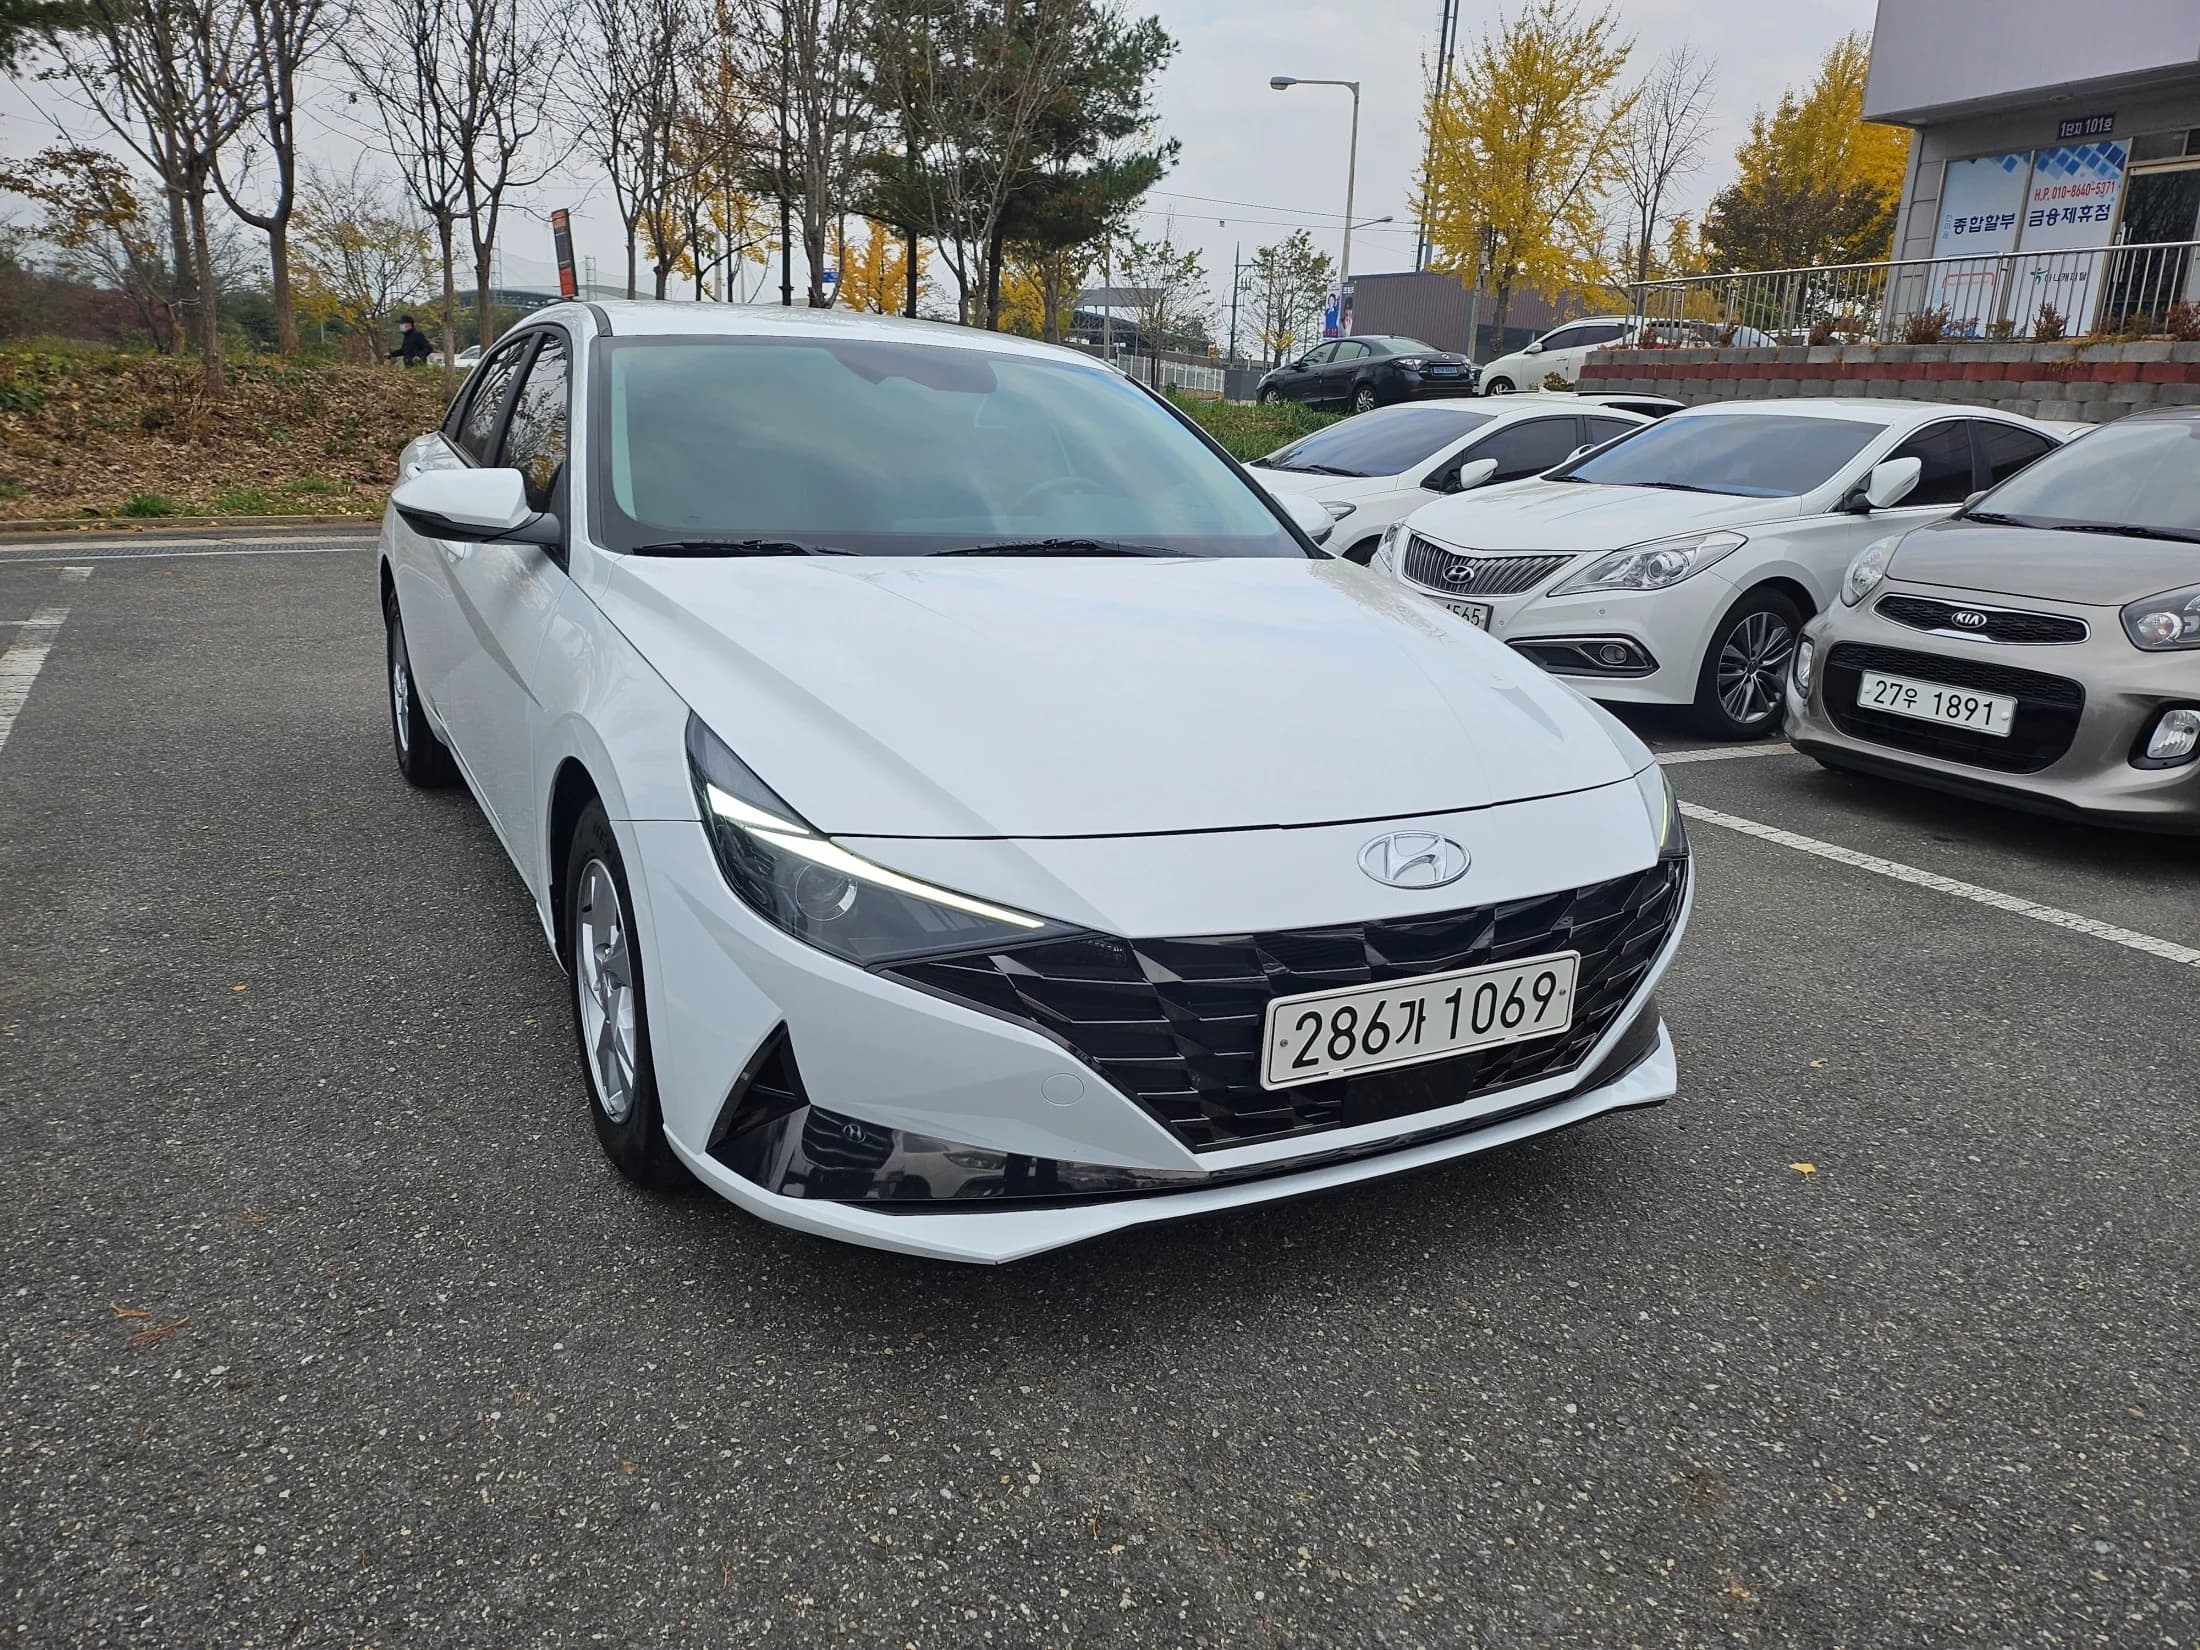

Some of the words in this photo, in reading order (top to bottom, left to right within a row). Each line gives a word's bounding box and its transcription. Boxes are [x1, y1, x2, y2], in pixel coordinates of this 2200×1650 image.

[2061, 122, 2083, 137] 1단지
[2086, 117, 2113, 133] 101호
[1953, 213, 2016, 235] 종합할부
[2029, 204, 2111, 227] 금융제휴점
[1446, 604, 1481, 626] 565
[1956, 612, 1980, 625] KIA
[1873, 680, 1918, 709] 27우
[1933, 691, 1993, 725] 1891
[1291, 998, 1426, 1069] 286가
[1445, 970, 1557, 1040] 1069
